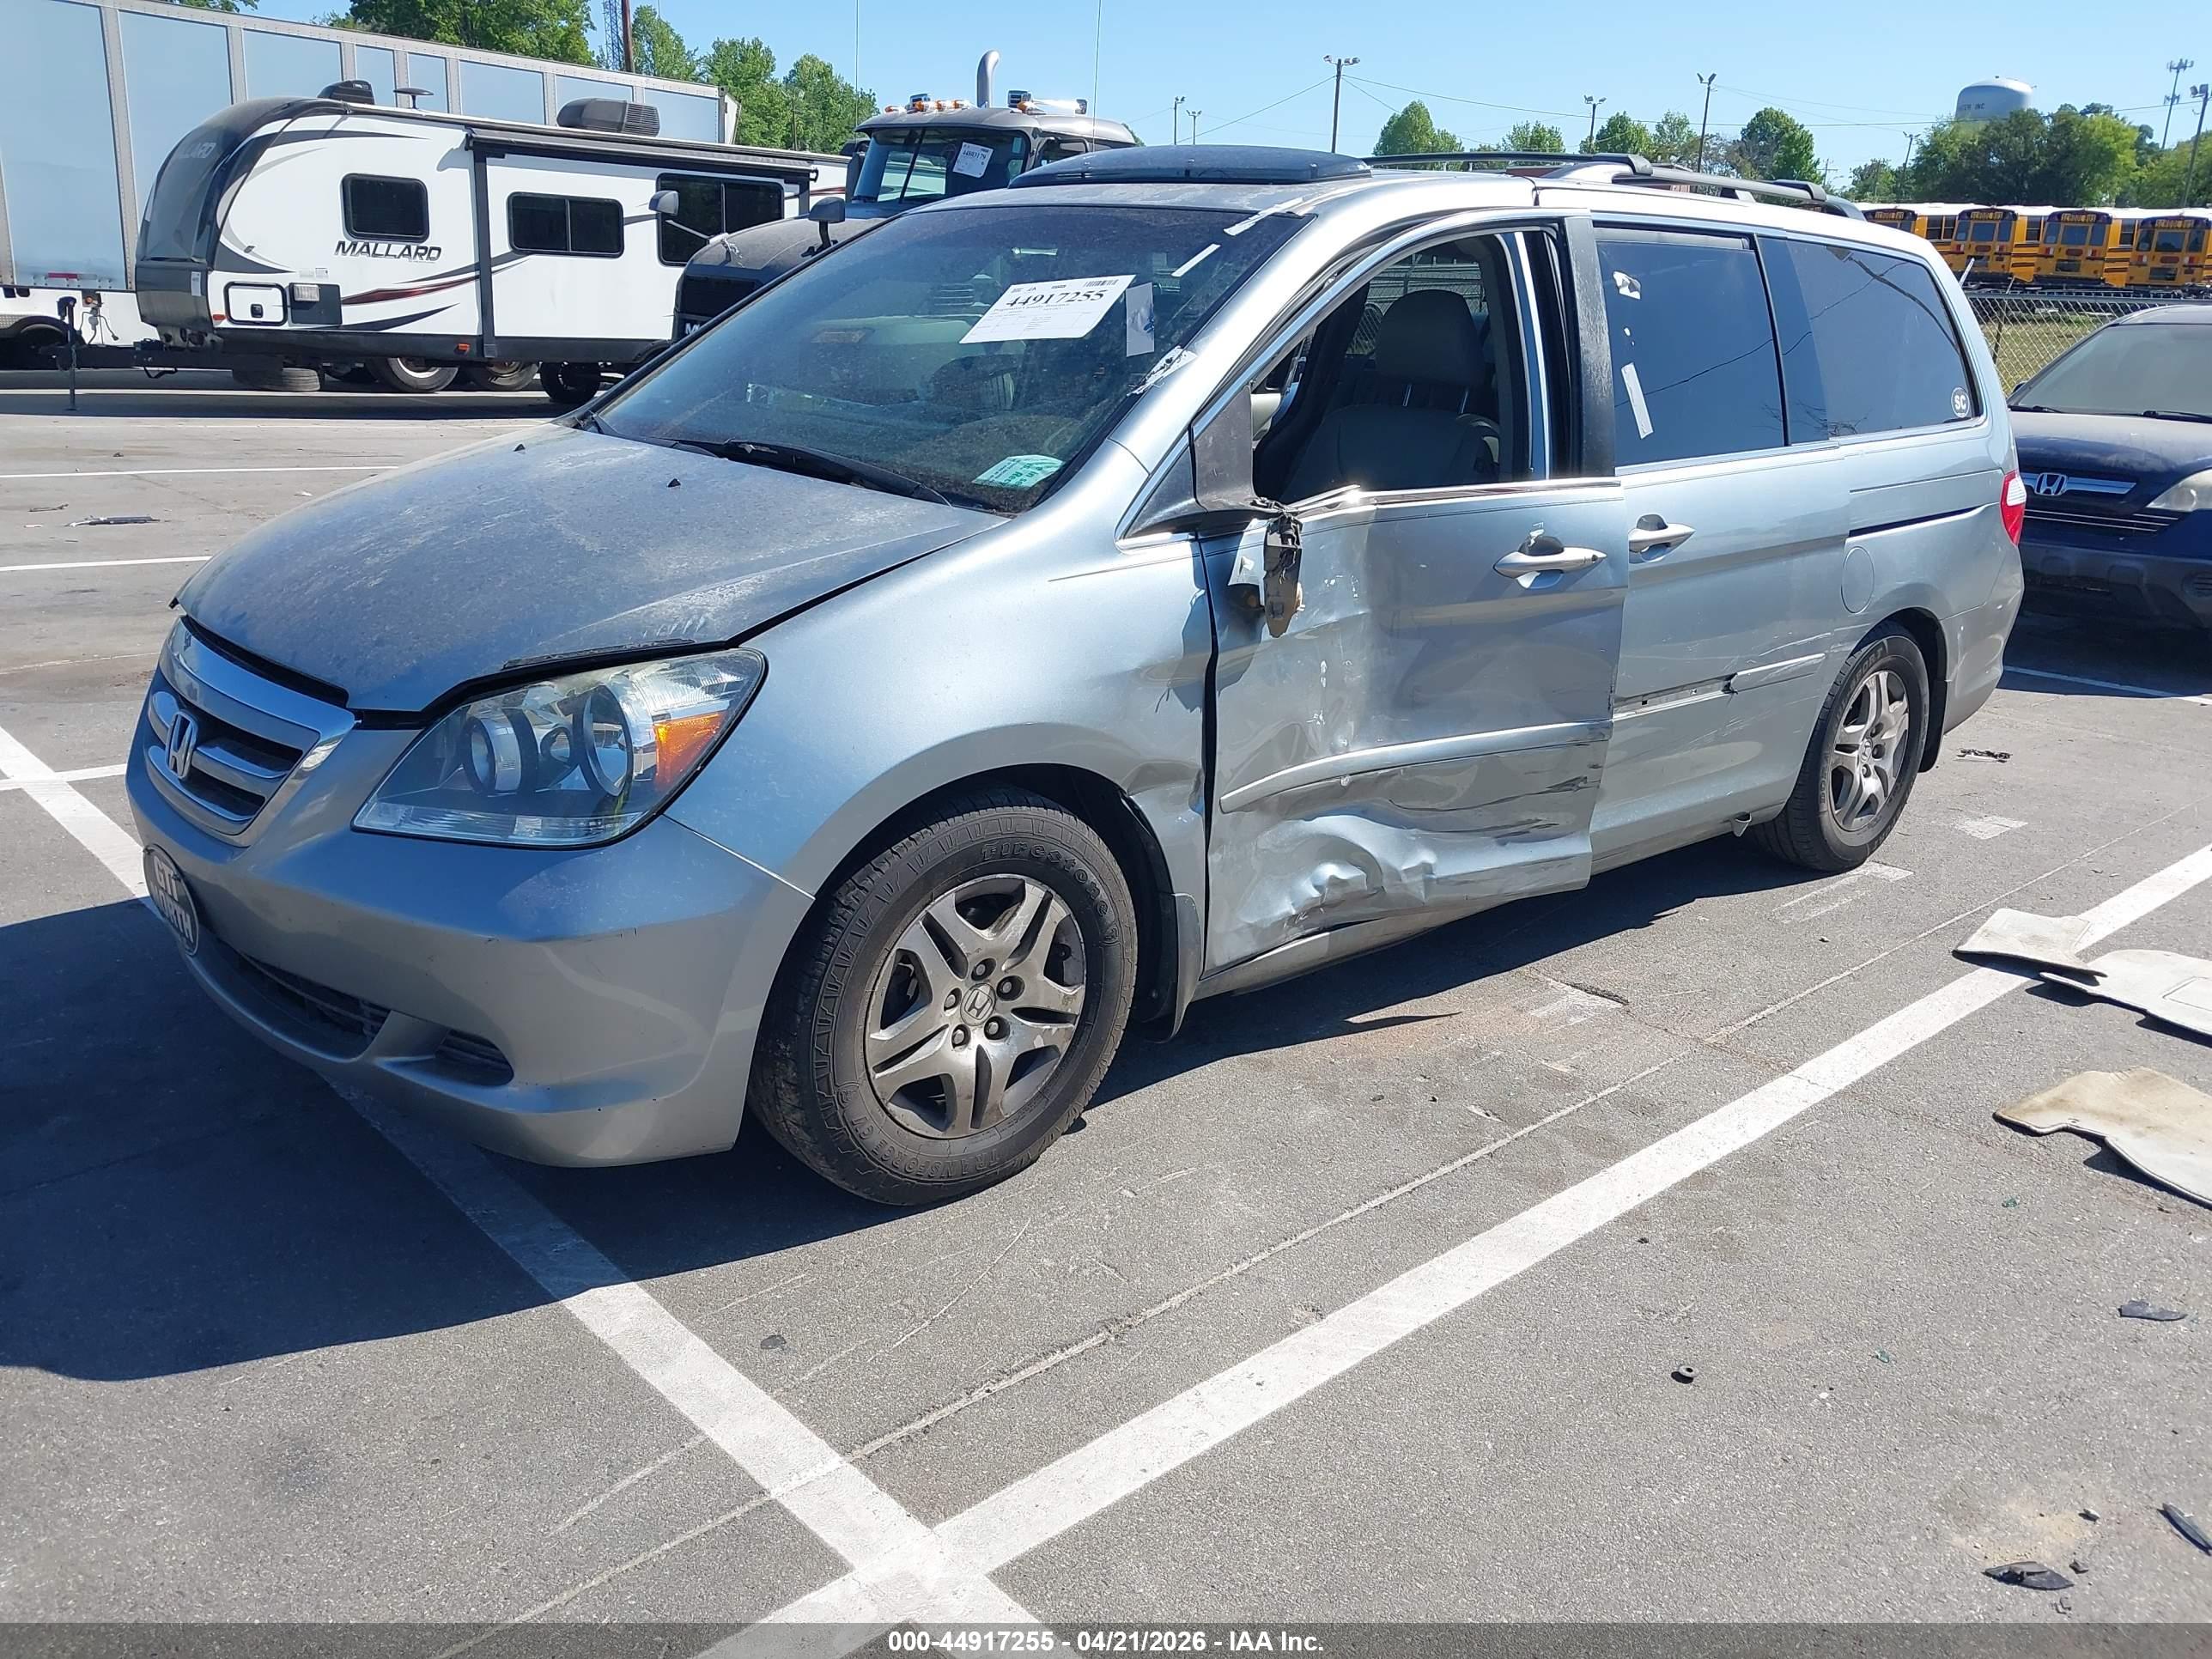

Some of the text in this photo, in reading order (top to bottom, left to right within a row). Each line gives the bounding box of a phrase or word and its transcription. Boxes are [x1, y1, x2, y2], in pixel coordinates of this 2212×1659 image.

[334, 240, 441, 261] MALLARD
[1006, 289, 1109, 307] 44917255
[1954, 394, 1967, 410] SC
[981, 841, 1109, 917] Firestone
